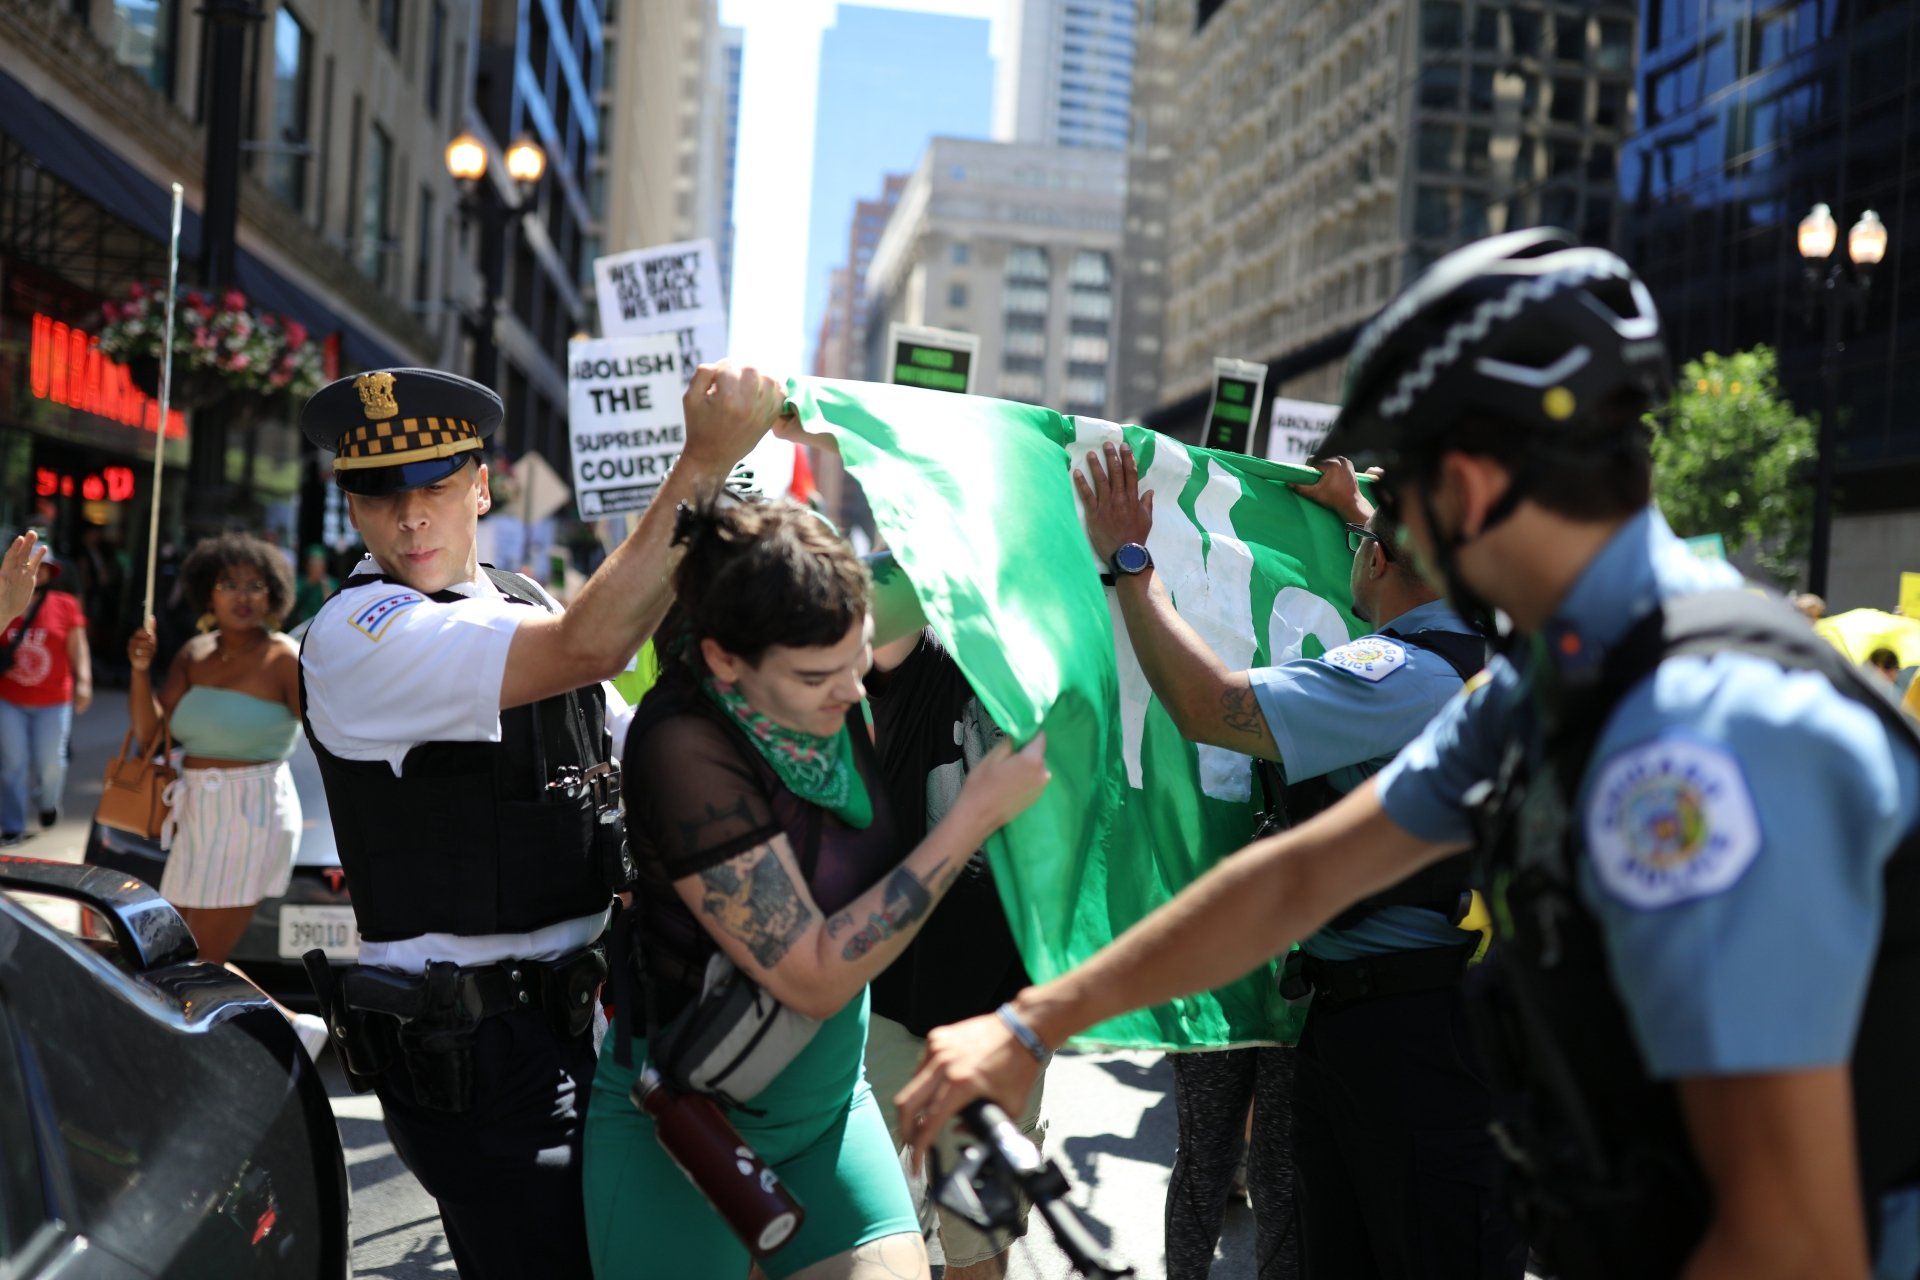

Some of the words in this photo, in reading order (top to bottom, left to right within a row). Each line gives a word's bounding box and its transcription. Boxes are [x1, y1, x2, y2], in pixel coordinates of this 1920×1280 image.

[608, 261, 637, 284] WE
[641, 252, 700, 276] WON'T
[646, 272, 698, 298] BACK
[622, 299, 649, 320] WE
[656, 288, 703, 314] WILL
[590, 384, 652, 414] THE
[575, 425, 683, 452] SUPREME
[581, 453, 678, 481] COURT
[1333, 651, 1374, 671] POLICE
[289, 921, 349, 947] 39010
